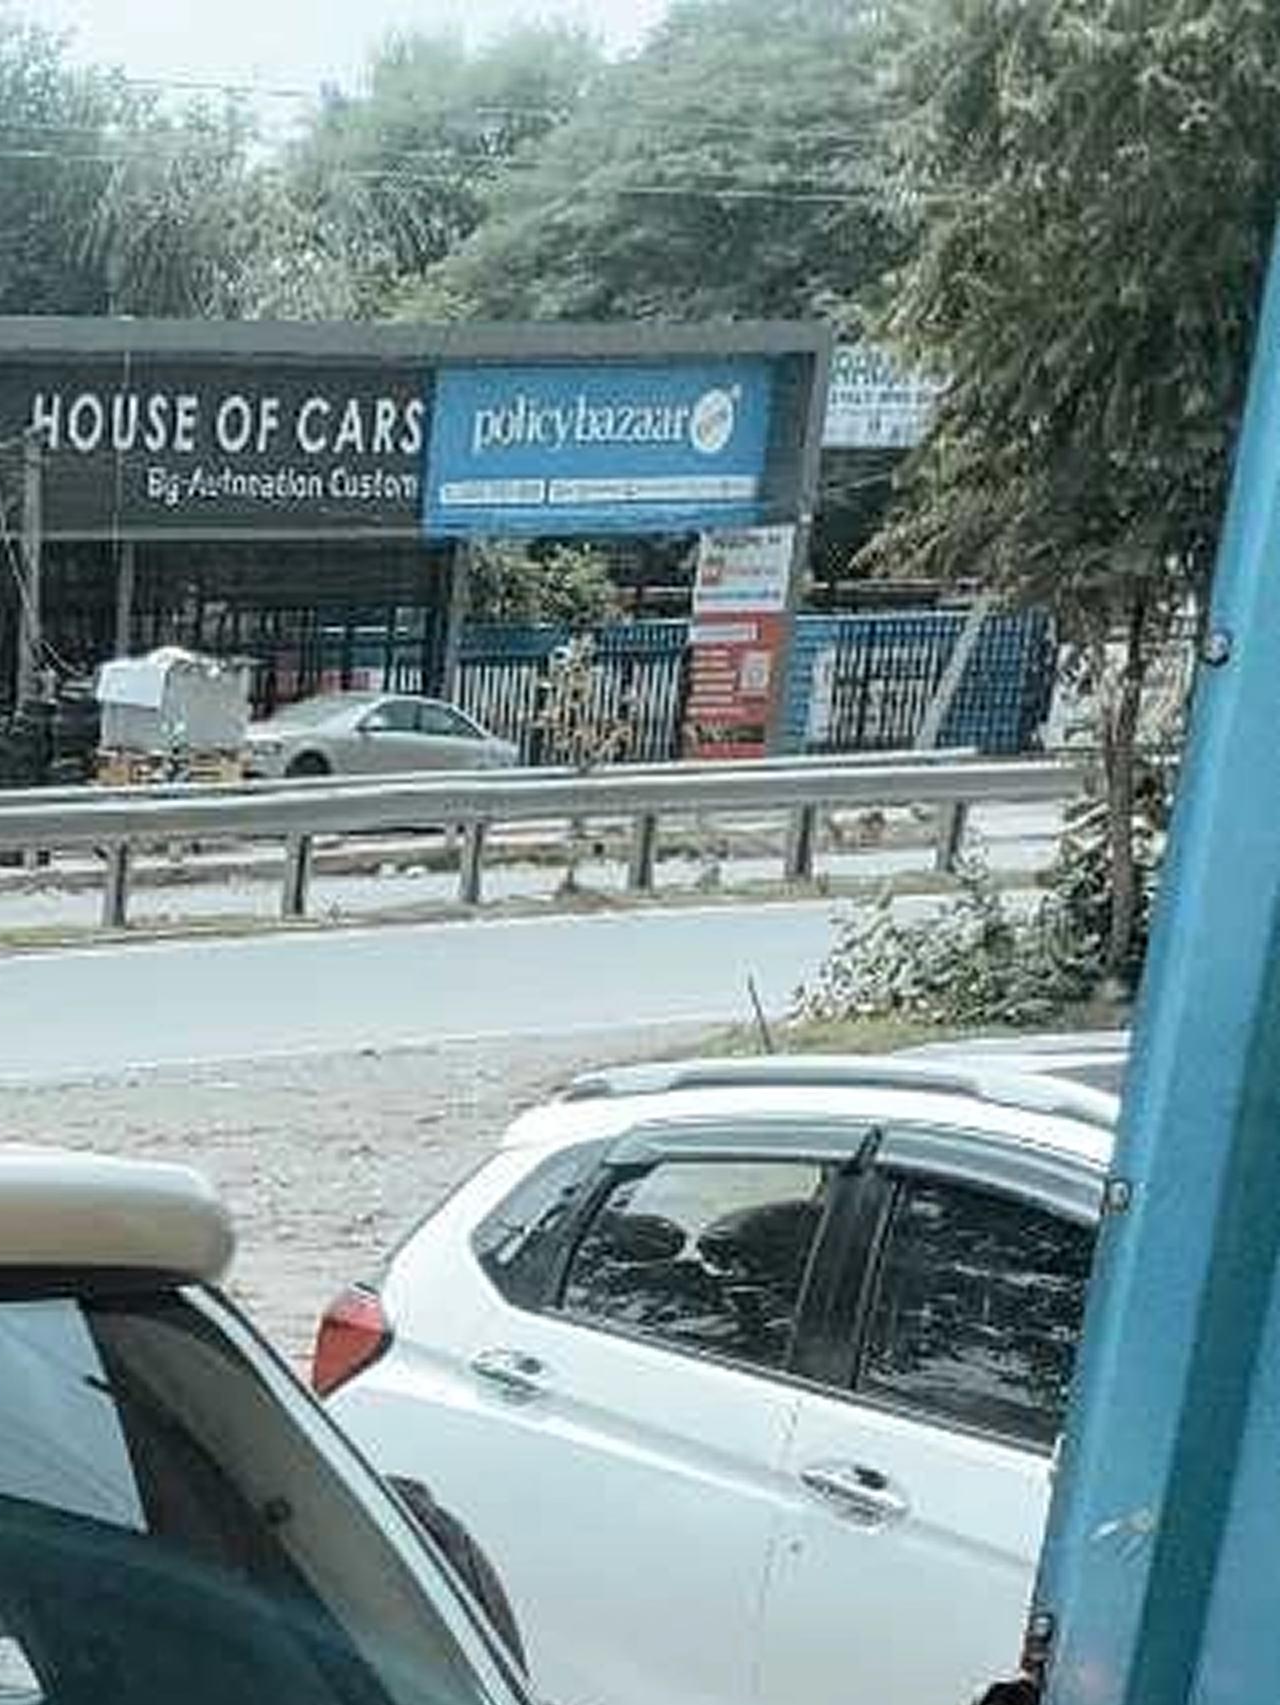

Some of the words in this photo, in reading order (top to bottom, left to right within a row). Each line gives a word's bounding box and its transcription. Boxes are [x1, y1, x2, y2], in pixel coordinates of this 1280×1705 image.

[32, 392, 199, 451] HOUSE
[216, 395, 280, 453] OF
[296, 397, 425, 454] CARS
[472, 393, 690, 454] policybazaar
[329, 467, 419, 500] Custom
